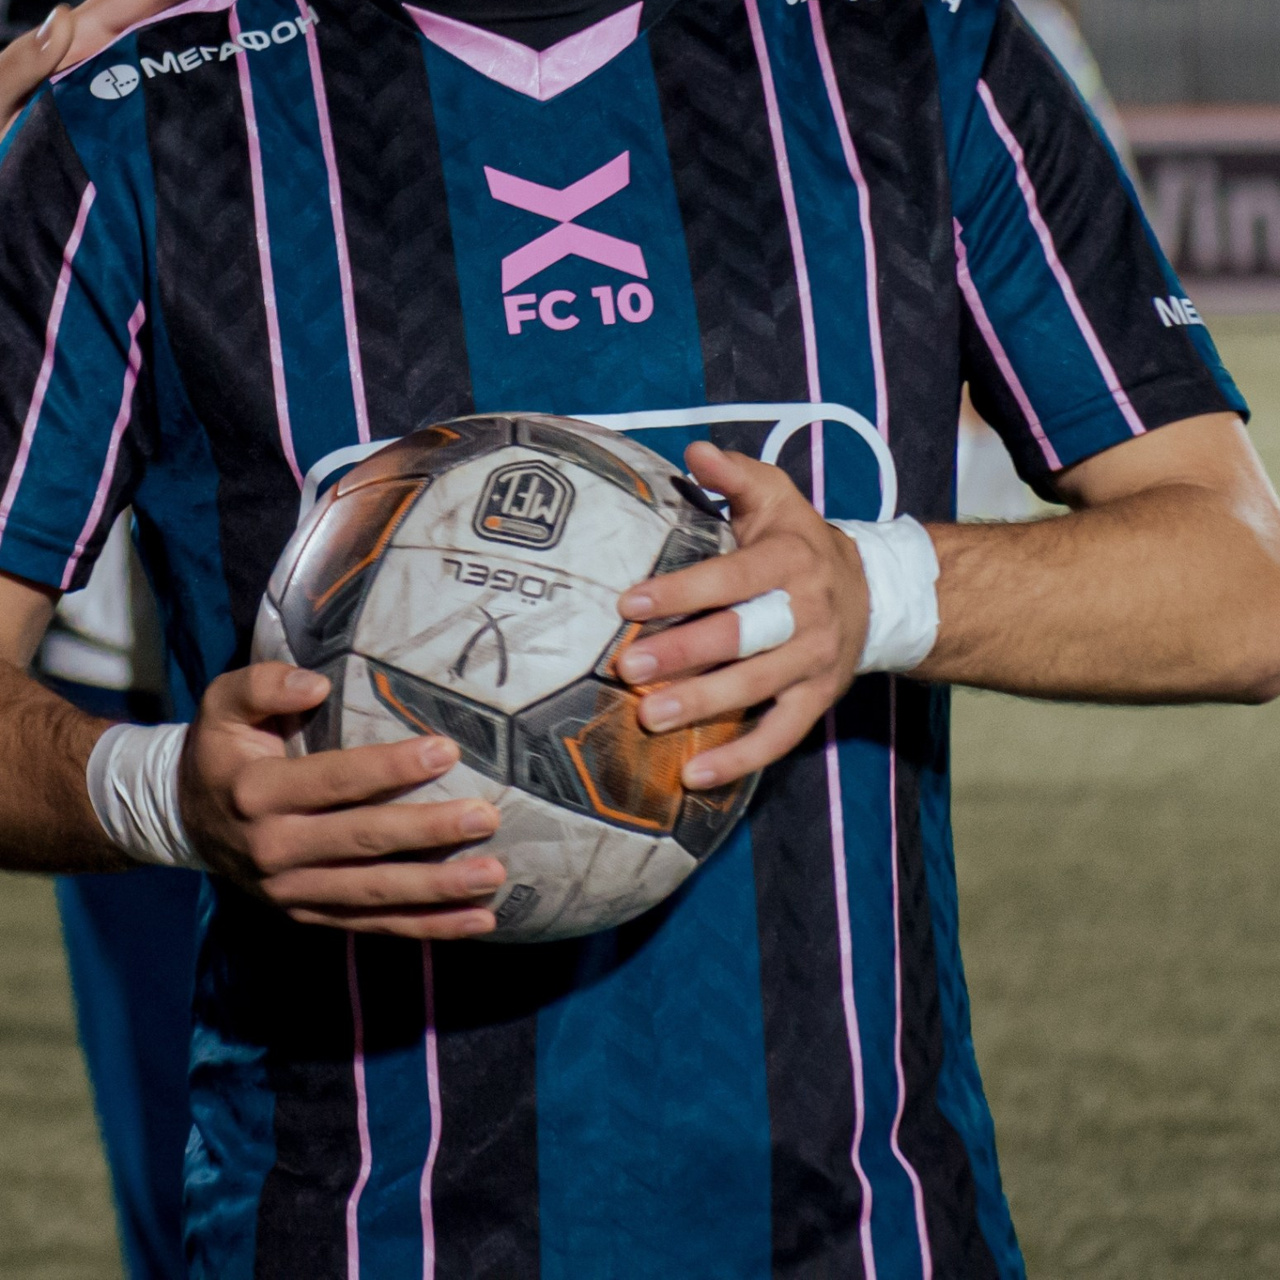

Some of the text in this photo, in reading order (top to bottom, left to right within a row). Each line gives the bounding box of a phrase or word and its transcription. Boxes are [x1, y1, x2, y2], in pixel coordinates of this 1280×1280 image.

[503, 282, 654, 335] FC 10
[442, 557, 573, 605] JÖGEL
